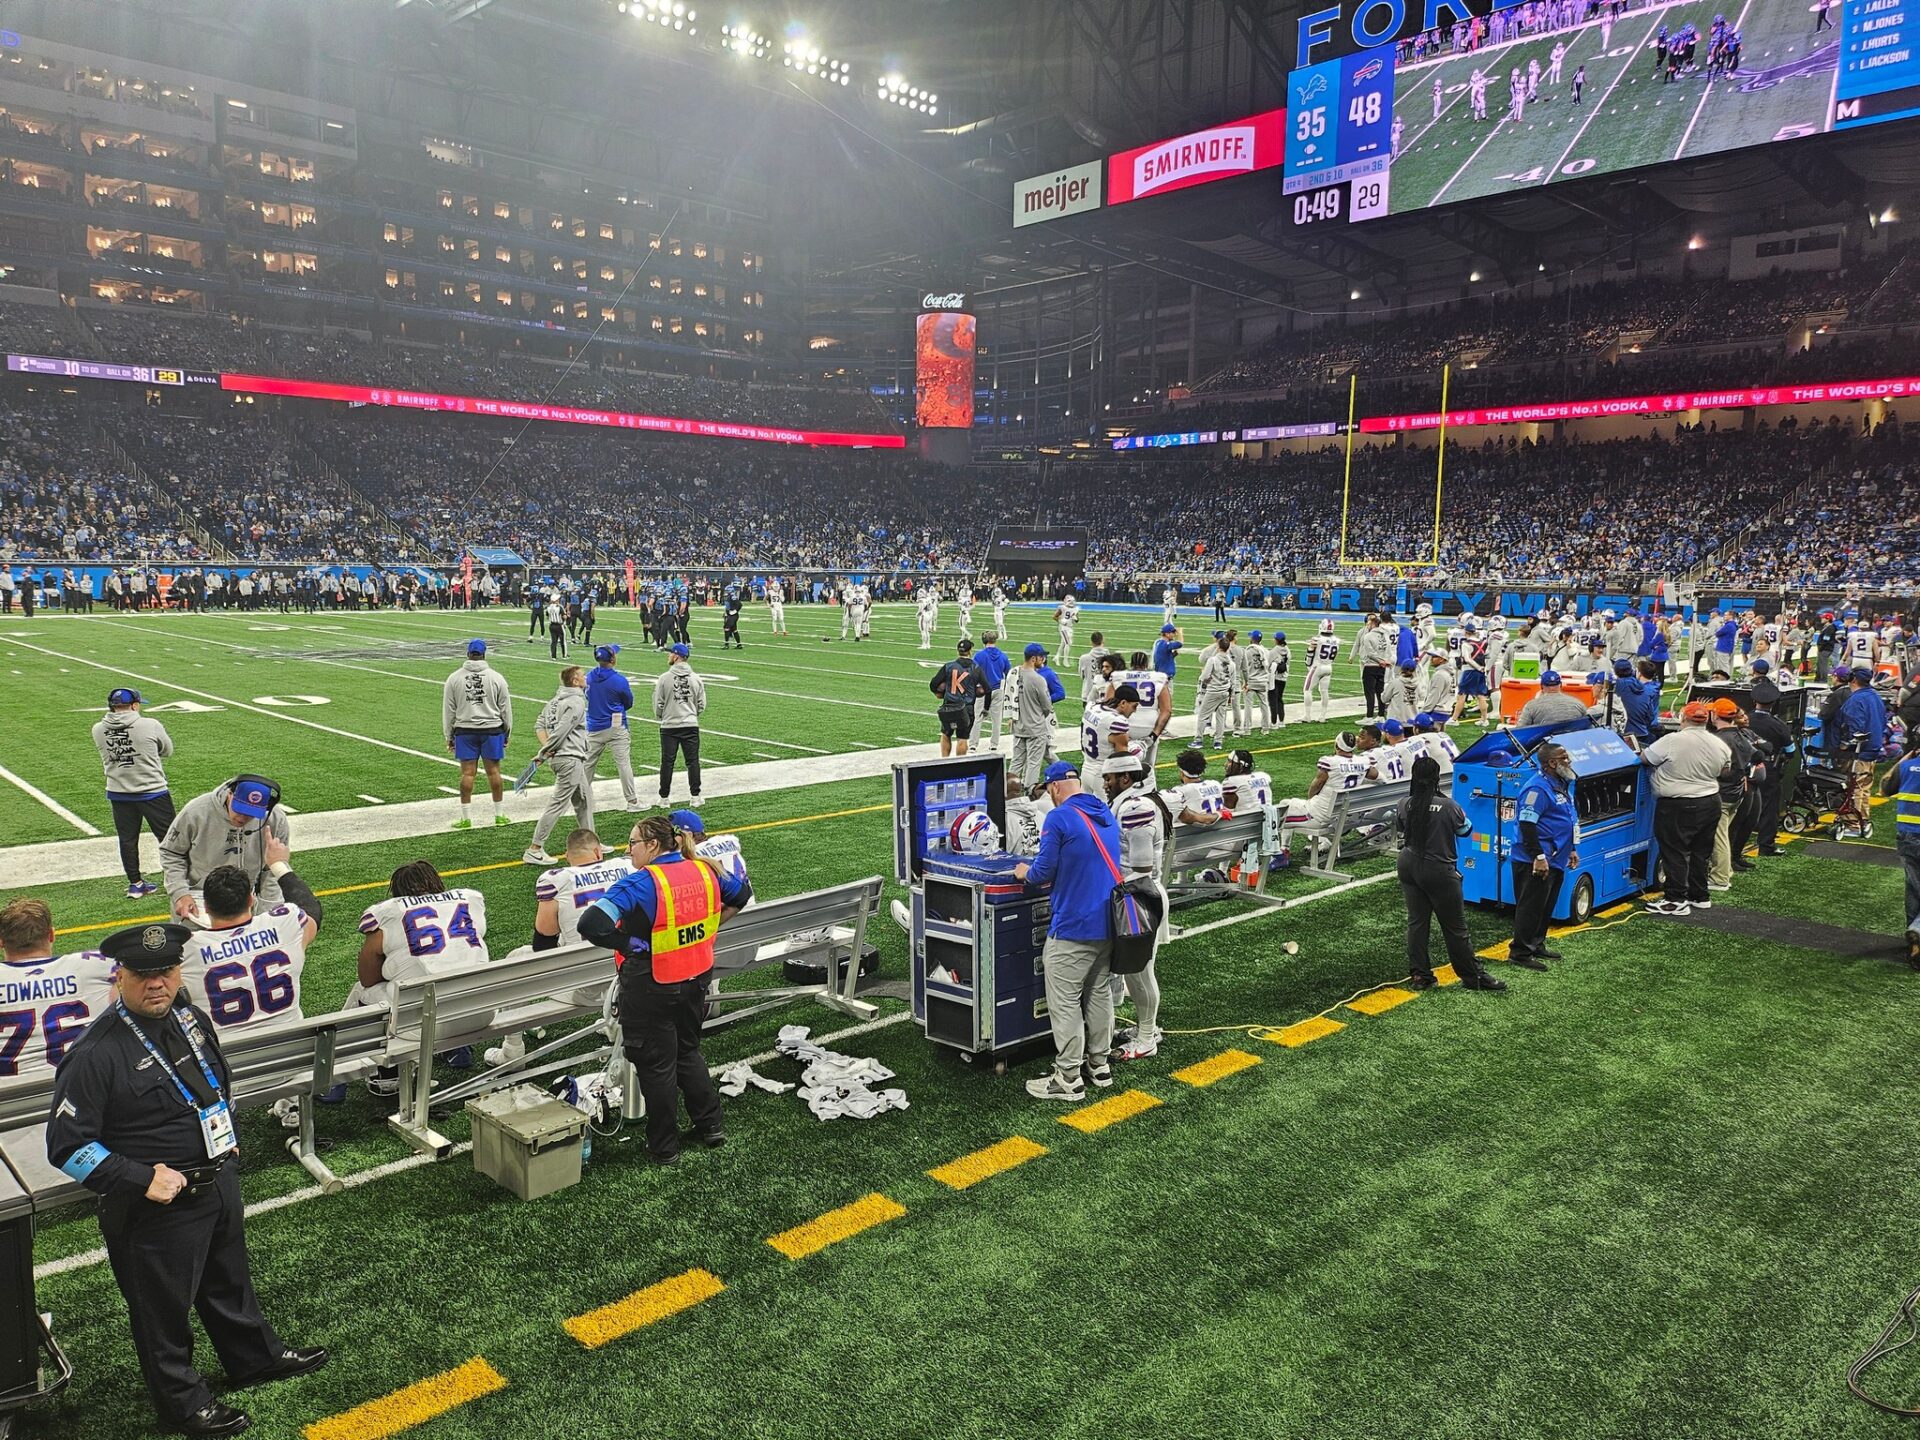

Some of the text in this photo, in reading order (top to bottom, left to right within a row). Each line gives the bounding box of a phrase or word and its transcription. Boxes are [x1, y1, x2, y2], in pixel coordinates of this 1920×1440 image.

[1863, 13, 1904, 32] M.JONES
[1861, 33, 1900, 51] J.HURTS
[1860, 49, 1910, 70] L.JACKSON
[1349, 92, 1381, 126] 48
[1296, 106, 1326, 141] 35
[1143, 137, 1244, 183] SMIRNOFF
[1309, 174, 1324, 186] 2ND
[1334, 169, 1343, 180] 10
[1371, 160, 1383, 171] 36
[1024, 174, 1090, 213] meijer
[1358, 183, 1381, 209] 29
[1294, 188, 1340, 225] 0:49
[64, 361, 79, 376] 10
[133, 367, 149, 381] 36
[159, 371, 177, 382] 29
[194, 376, 217, 384] DELTA
[396, 395, 439, 406] SMIRNOFF
[1693, 394, 1744, 407] SMIRNOFF
[1793, 389, 1823, 399] THE
[1829, 383, 1904, 397] WORLD'S
[475, 402, 610, 423] THE WORLD'S No.1 VODKA
[1486, 400, 1649, 421] THE WORLD'S No.1 VODKA
[1411, 416, 1450, 427] SMIRNOF
[699, 424, 803, 442] THE WORLD'S No.1 VODKA
[852, 597, 863, 605] 92
[1319, 644, 1337, 660] 58
[1857, 639, 1867, 651] 2
[951, 669, 970, 695] K
[1340, 763, 1366, 773] COLEMAN
[1258, 789, 1266, 805] 1
[575, 868, 629, 889] ANDERSON
[400, 890, 467, 908] TORRENCE
[402, 903, 482, 957] 64
[678, 922, 705, 946] EMS
[200, 928, 279, 964] McGOVERN
[0, 975, 78, 1005] EDWARDS
[204, 949, 294, 1027] 66
[0, 1000, 90, 1077] 76
